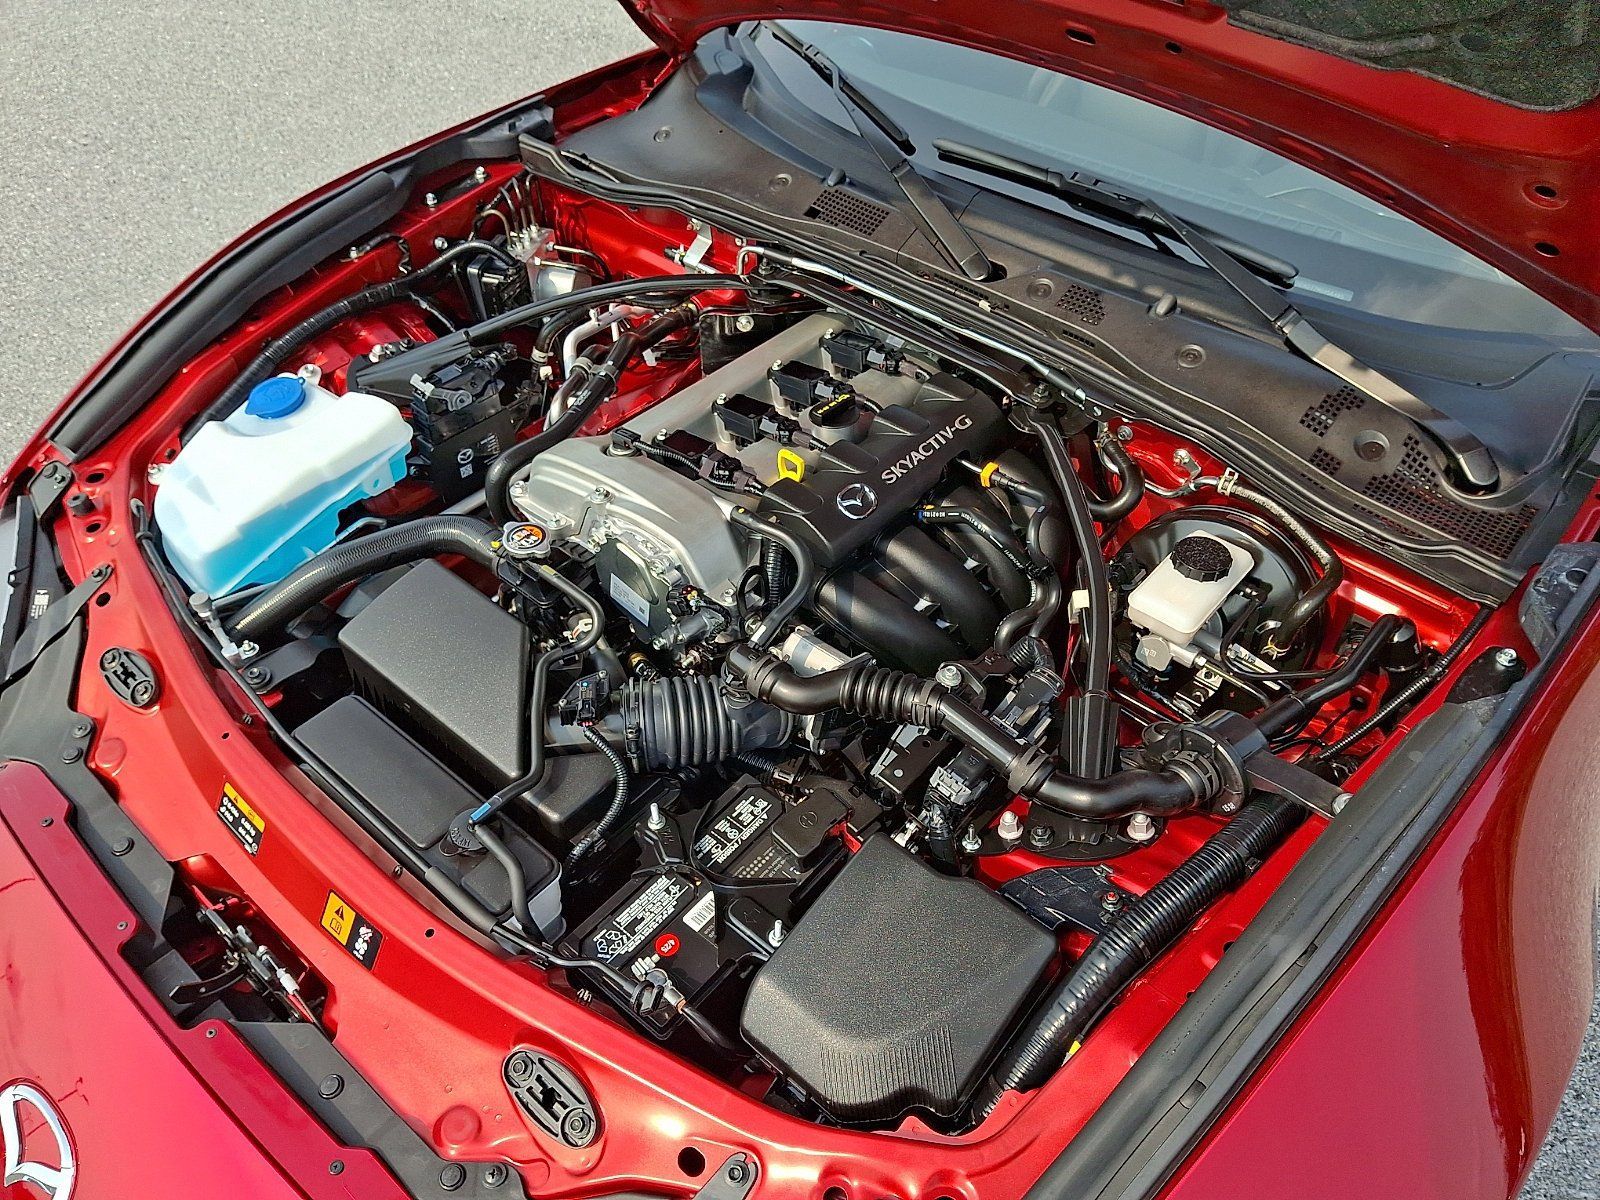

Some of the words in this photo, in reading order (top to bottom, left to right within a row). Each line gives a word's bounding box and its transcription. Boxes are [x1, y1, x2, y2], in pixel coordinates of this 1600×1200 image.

[881, 414, 973, 484] SKYACTIV-G
[740, 818, 764, 841] DANGER
[716, 842, 740, 864] POISON
